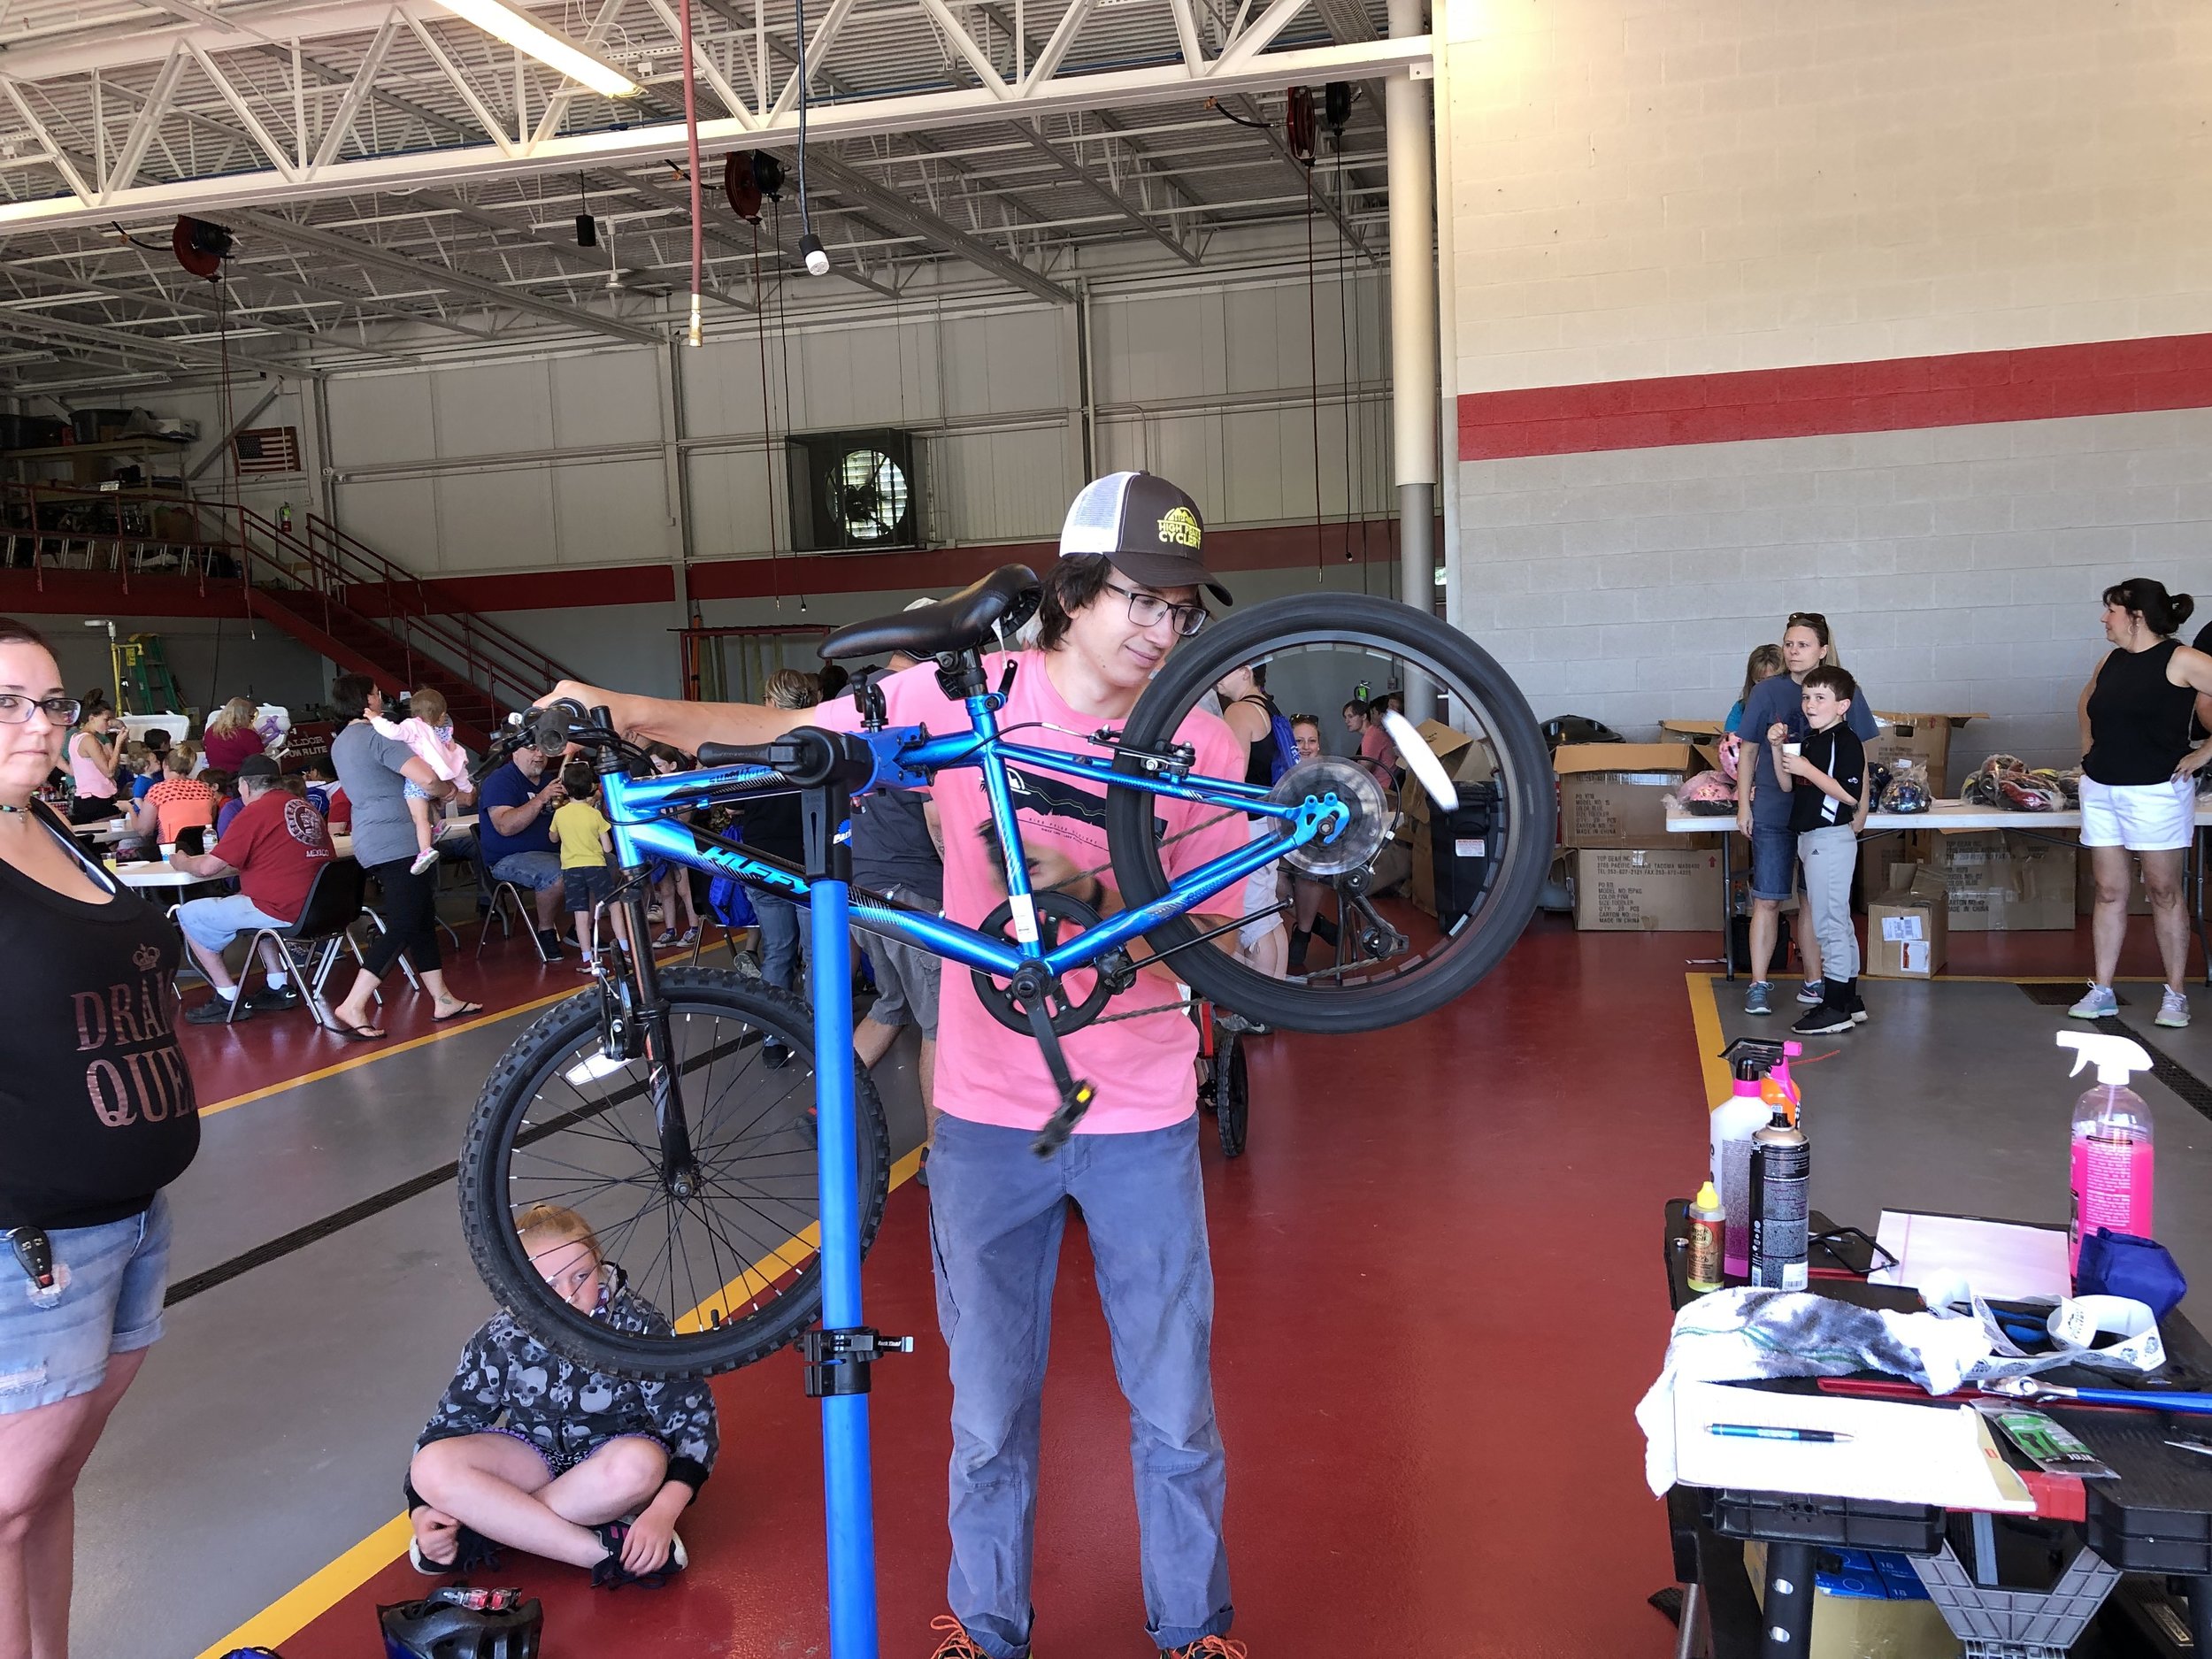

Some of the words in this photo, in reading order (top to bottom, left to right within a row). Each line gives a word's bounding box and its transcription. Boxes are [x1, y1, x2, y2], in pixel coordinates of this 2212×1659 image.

[1158, 521, 1183, 533] HIGH
[1159, 531, 1202, 549] CYCLERY
[702, 846, 811, 895] HUFFY
